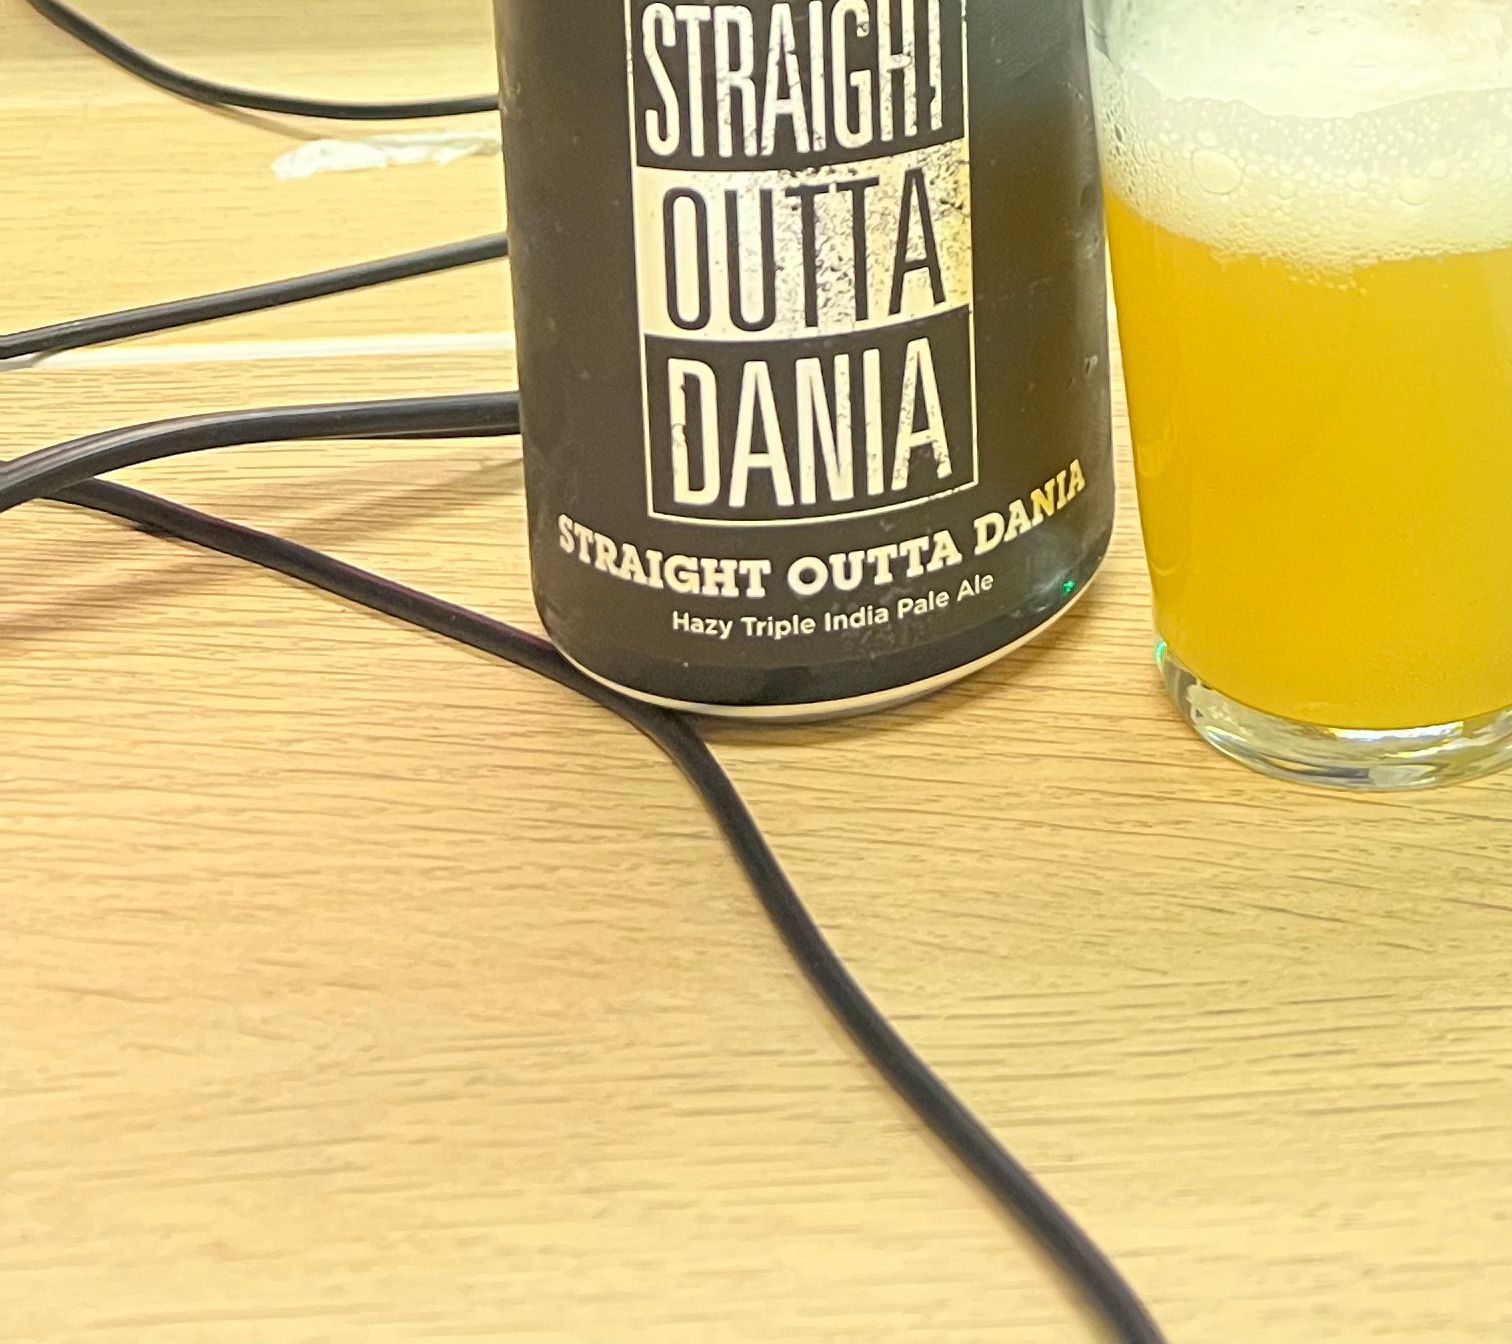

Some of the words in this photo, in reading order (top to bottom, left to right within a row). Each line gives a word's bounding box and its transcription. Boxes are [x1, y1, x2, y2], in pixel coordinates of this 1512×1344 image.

[661, 167, 948, 332] OUTTA
[667, 337, 952, 508] DANIA
[557, 513, 774, 599] STRAIGHT
[787, 529, 963, 597] OUTTA
[973, 458, 1087, 553] DANIA
[672, 610, 734, 640] Hazy
[741, 614, 817, 640] Triple
[824, 605, 890, 633] India
[898, 588, 950, 621] Pale
[957, 572, 995, 603] Ale
